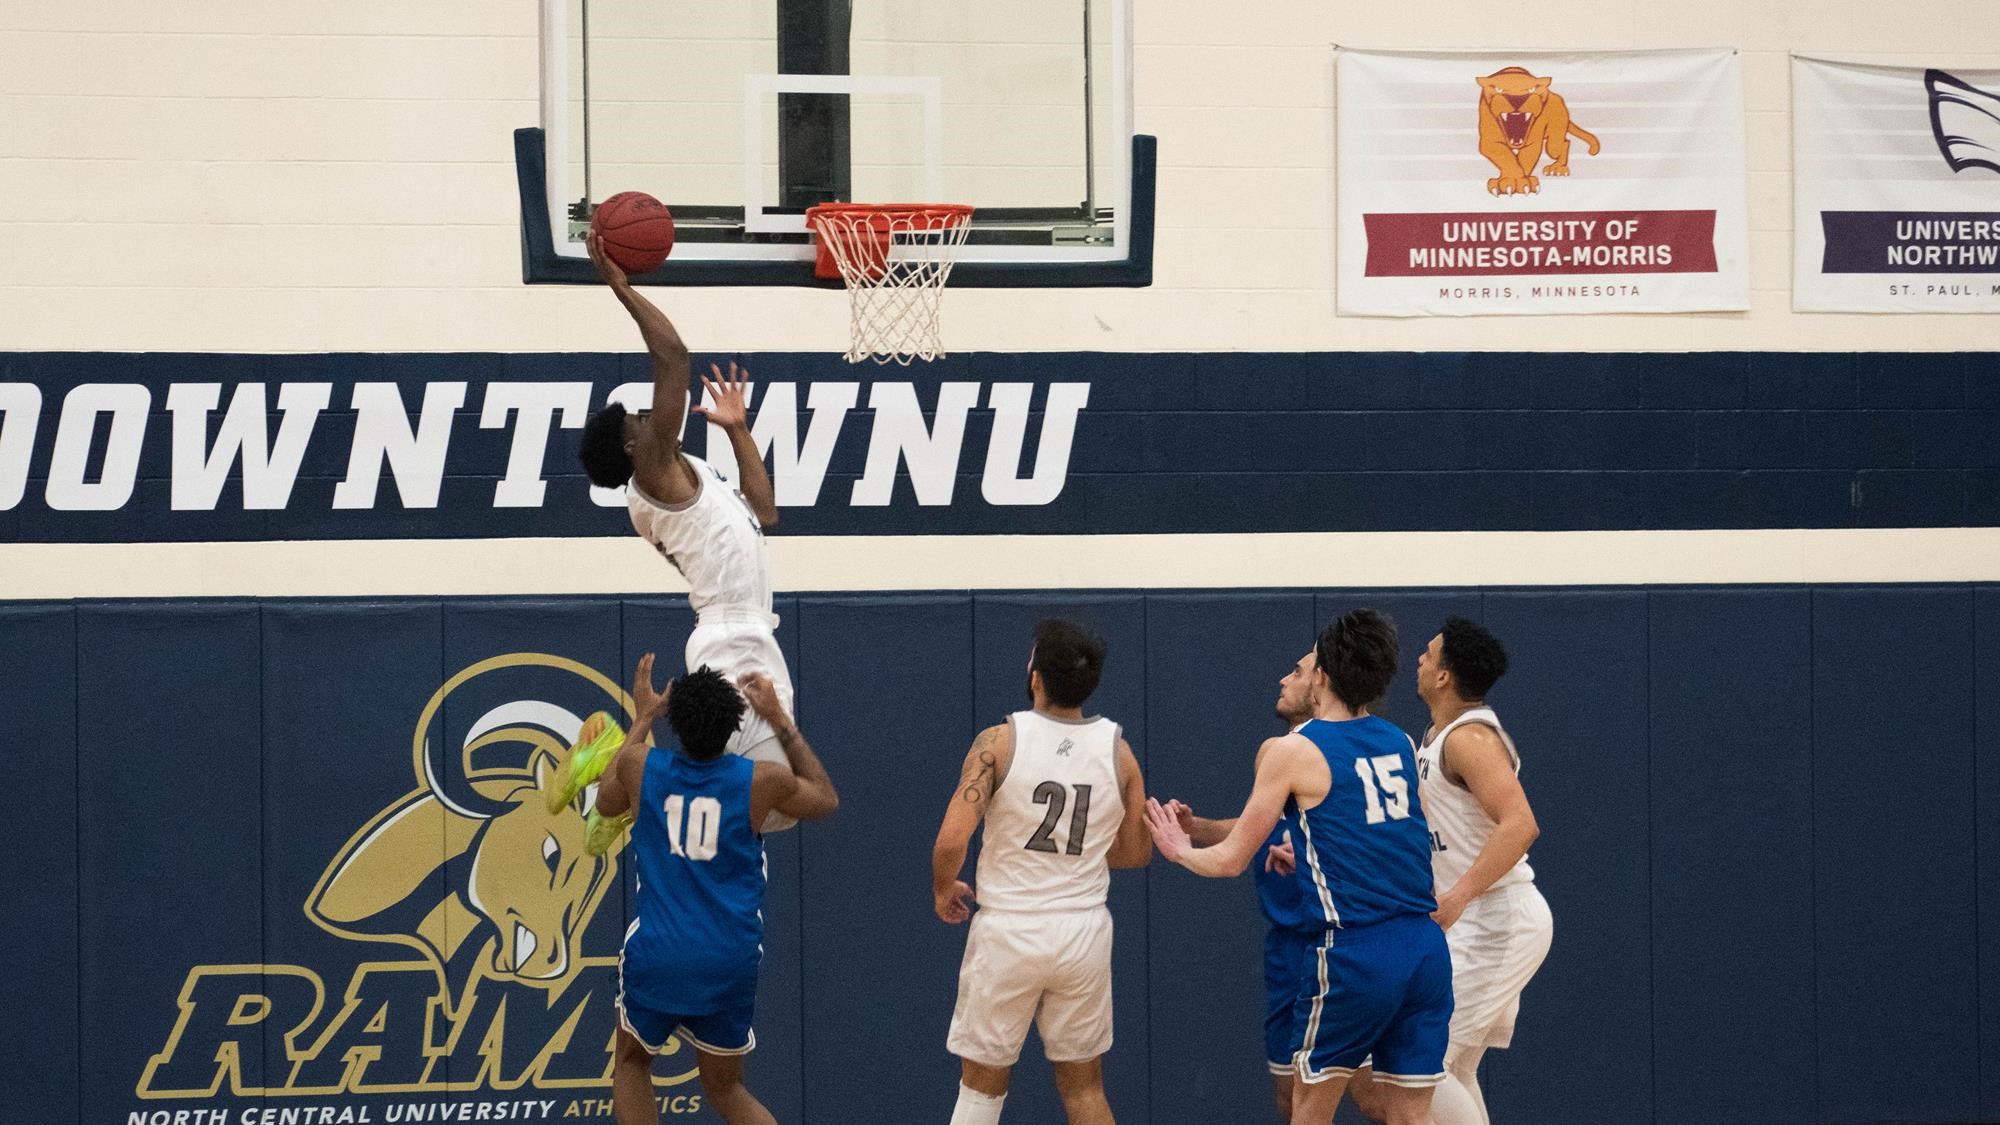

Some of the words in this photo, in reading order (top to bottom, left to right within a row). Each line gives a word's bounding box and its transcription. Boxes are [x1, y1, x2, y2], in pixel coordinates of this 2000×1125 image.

[1442, 220, 1597, 243] UNIVERSITY
[1605, 219, 1639, 241] OF
[1409, 244, 1673, 268] MINNESOTA-MORRIS
[1439, 287, 1521, 299] MORRIS,
[1532, 285, 1641, 297] MINNESOTA
[1889, 285, 1916, 296] ST.
[1354, 753, 1411, 825] 15
[663, 794, 722, 861] 10
[1024, 781, 1093, 856] 21
[127, 1108, 229, 1125] NORTH
[240, 1105, 371, 1125] CENTRAL
[384, 1100, 556, 1122] UNIVERSITY
[562, 1095, 702, 1118] ATHICS
